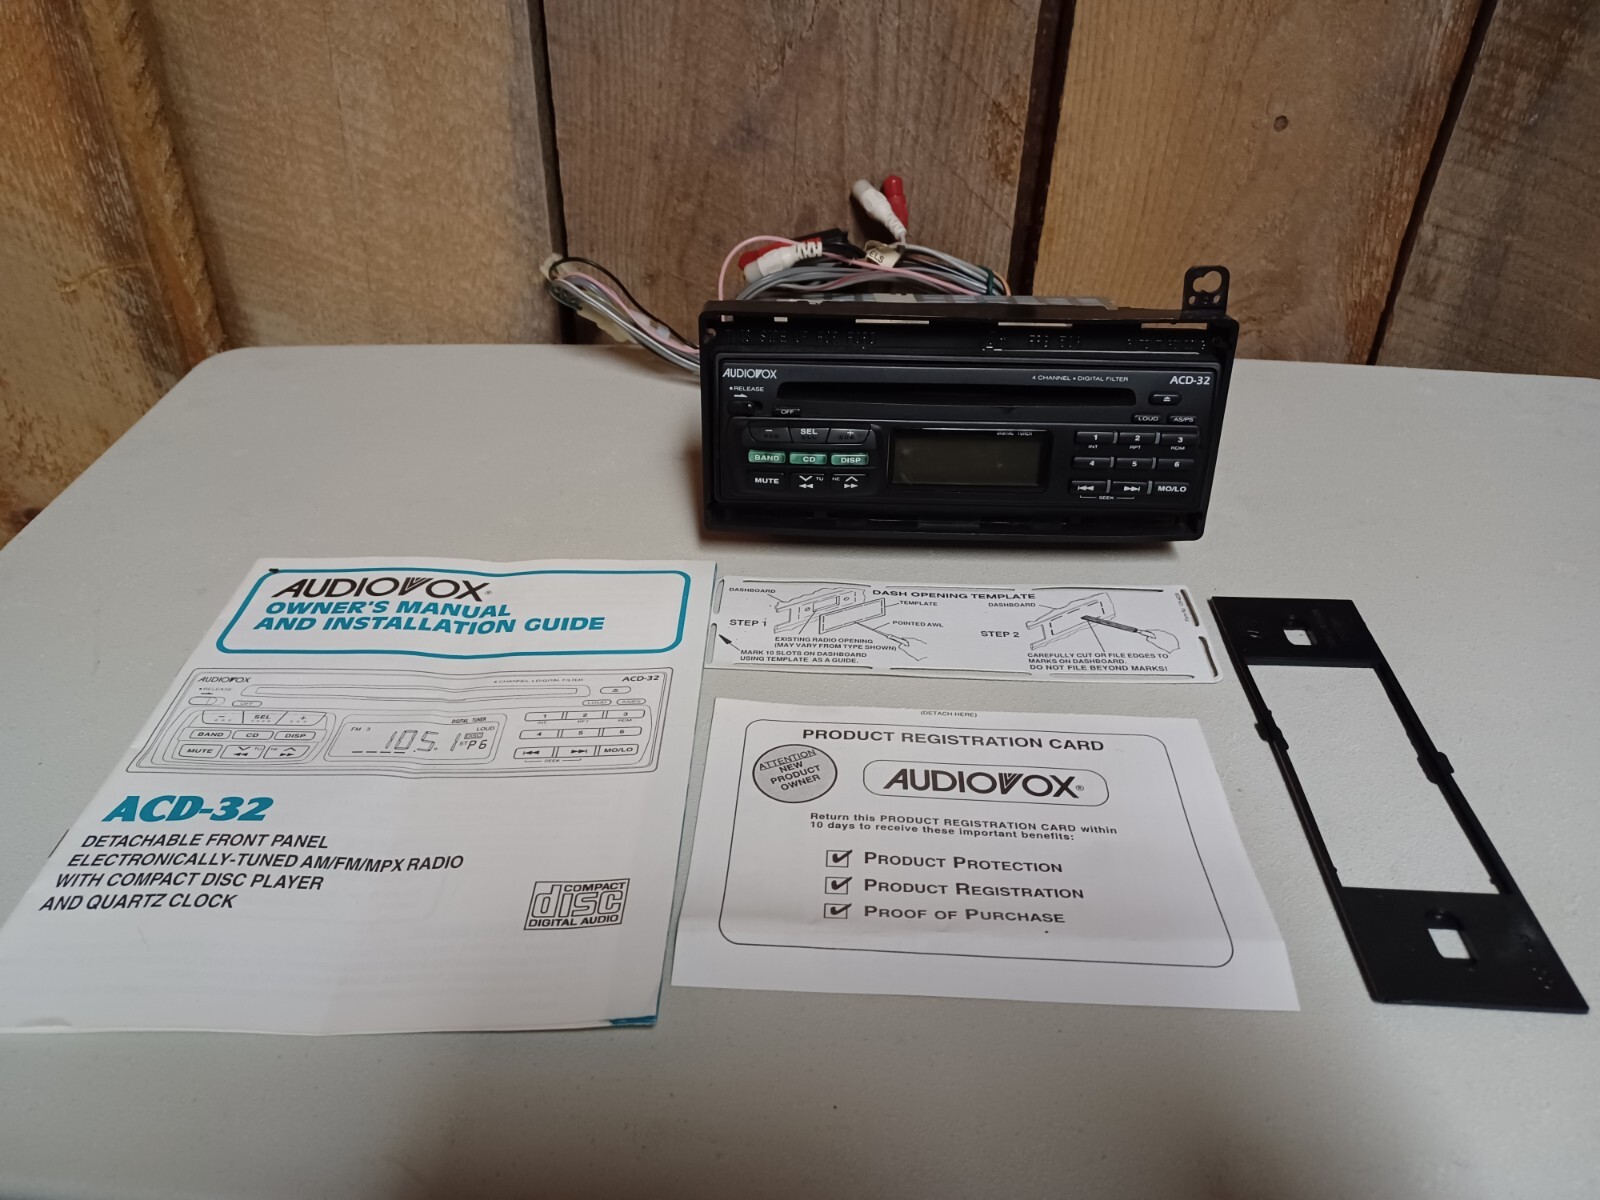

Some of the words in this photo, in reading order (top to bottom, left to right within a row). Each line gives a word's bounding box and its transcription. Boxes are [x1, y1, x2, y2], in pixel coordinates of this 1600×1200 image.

[722, 368, 777, 379] AUDIOVOX
[1170, 376, 1210, 385] ACD-32
[754, 454, 780, 462] BAND
[1158, 485, 1187, 493] MO/LO
[911, 591, 968, 599] OPENING
[265, 600, 392, 616] OWNER'S
[396, 601, 512, 618] MANUAL
[253, 616, 318, 630] AND
[322, 617, 517, 635] INSTALLATION
[523, 616, 606, 631] GUIDE
[730, 619, 759, 627] STEP
[802, 729, 896, 742] PRODUCT
[900, 732, 1043, 749] REGISTRATION
[1048, 737, 1104, 752] CARD
[758, 748, 817, 772] ATTENTION
[778, 760, 804, 774] NEW
[770, 764, 821, 785] PRODUCT
[780, 773, 821, 792] OWNER
[101, 795, 274, 823] ACD-32
[810, 812, 849, 821] Return
[853, 814, 876, 822] this
[879, 815, 938, 826] PRODUCT
[943, 818, 1036, 830] REGISTRATION
[1040, 822, 1076, 832] CARD
[1081, 824, 1118, 834] within
[811, 821, 824, 829] 10
[827, 821, 855, 831] days
[876, 824, 918, 833] receive
[922, 826, 955, 834] these
[959, 827, 1018, 838] important
[1021, 830, 1074, 841] benefits:
[81, 833, 204, 848] DETACHABLE
[206, 834, 269, 848] FRONT
[270, 834, 329, 849] PANEL
[67, 853, 298, 868] ELECTRONICALLY-TUNED
[300, 855, 404, 874] AM/FM/MPX
[407, 855, 464, 871] RADIO
[55, 873, 102, 889] WITH
[104, 872, 199, 888] COMPACT
[200, 872, 246, 888] DISC
[249, 873, 324, 891] PLAYER
[563, 882, 626, 892] COMPACT
[39, 895, 83, 911] AND
[86, 894, 167, 910] QUARTZ
[168, 894, 238, 909] CLOCK
[533, 884, 624, 918] disc
[528, 918, 575, 928] DIGITAL
[579, 915, 619, 926] AUDIO
